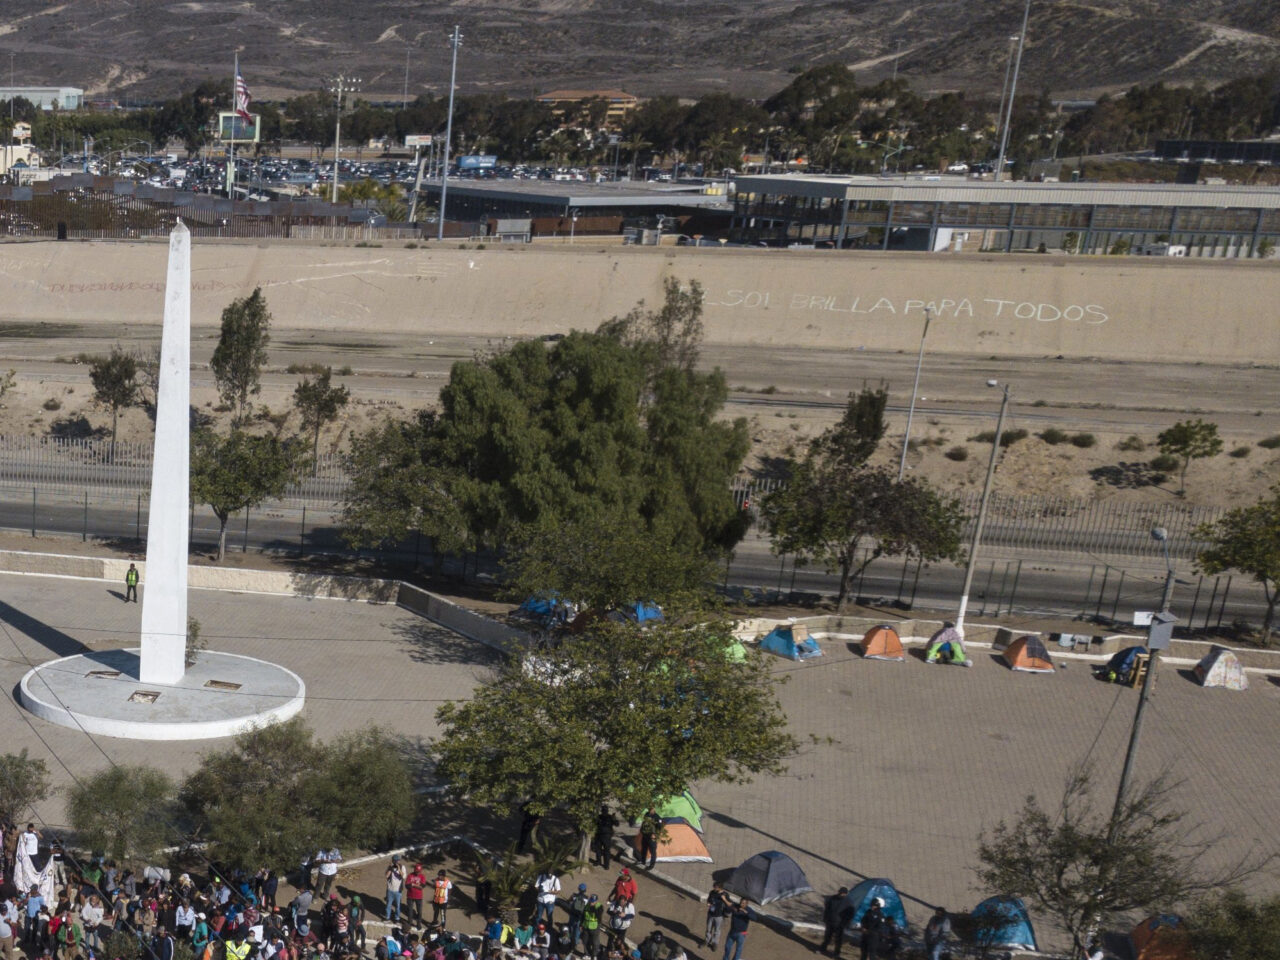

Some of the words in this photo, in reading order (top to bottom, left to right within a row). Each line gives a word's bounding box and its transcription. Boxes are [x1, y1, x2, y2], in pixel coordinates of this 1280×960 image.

[790, 294, 897, 314] BRILLA
[904, 299, 973, 316] PARA
[984, 299, 1109, 324] TODOS
